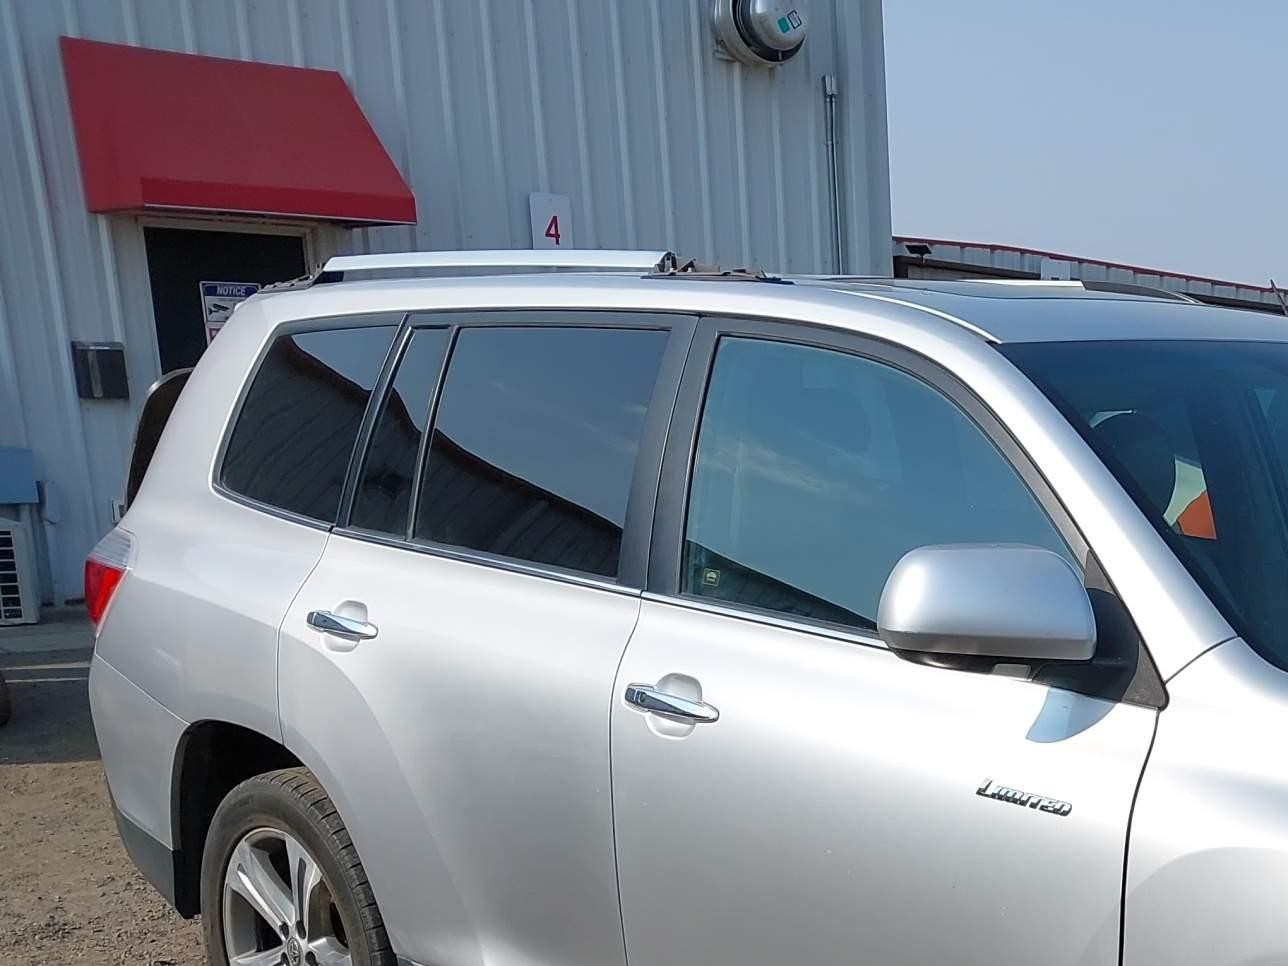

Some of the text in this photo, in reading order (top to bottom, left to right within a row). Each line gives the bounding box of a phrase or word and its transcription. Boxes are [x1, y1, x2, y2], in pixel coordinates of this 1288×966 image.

[545, 215, 560, 245] 4
[216, 286, 246, 296] NOTICE
[976, 777, 1072, 816] LIMITED
